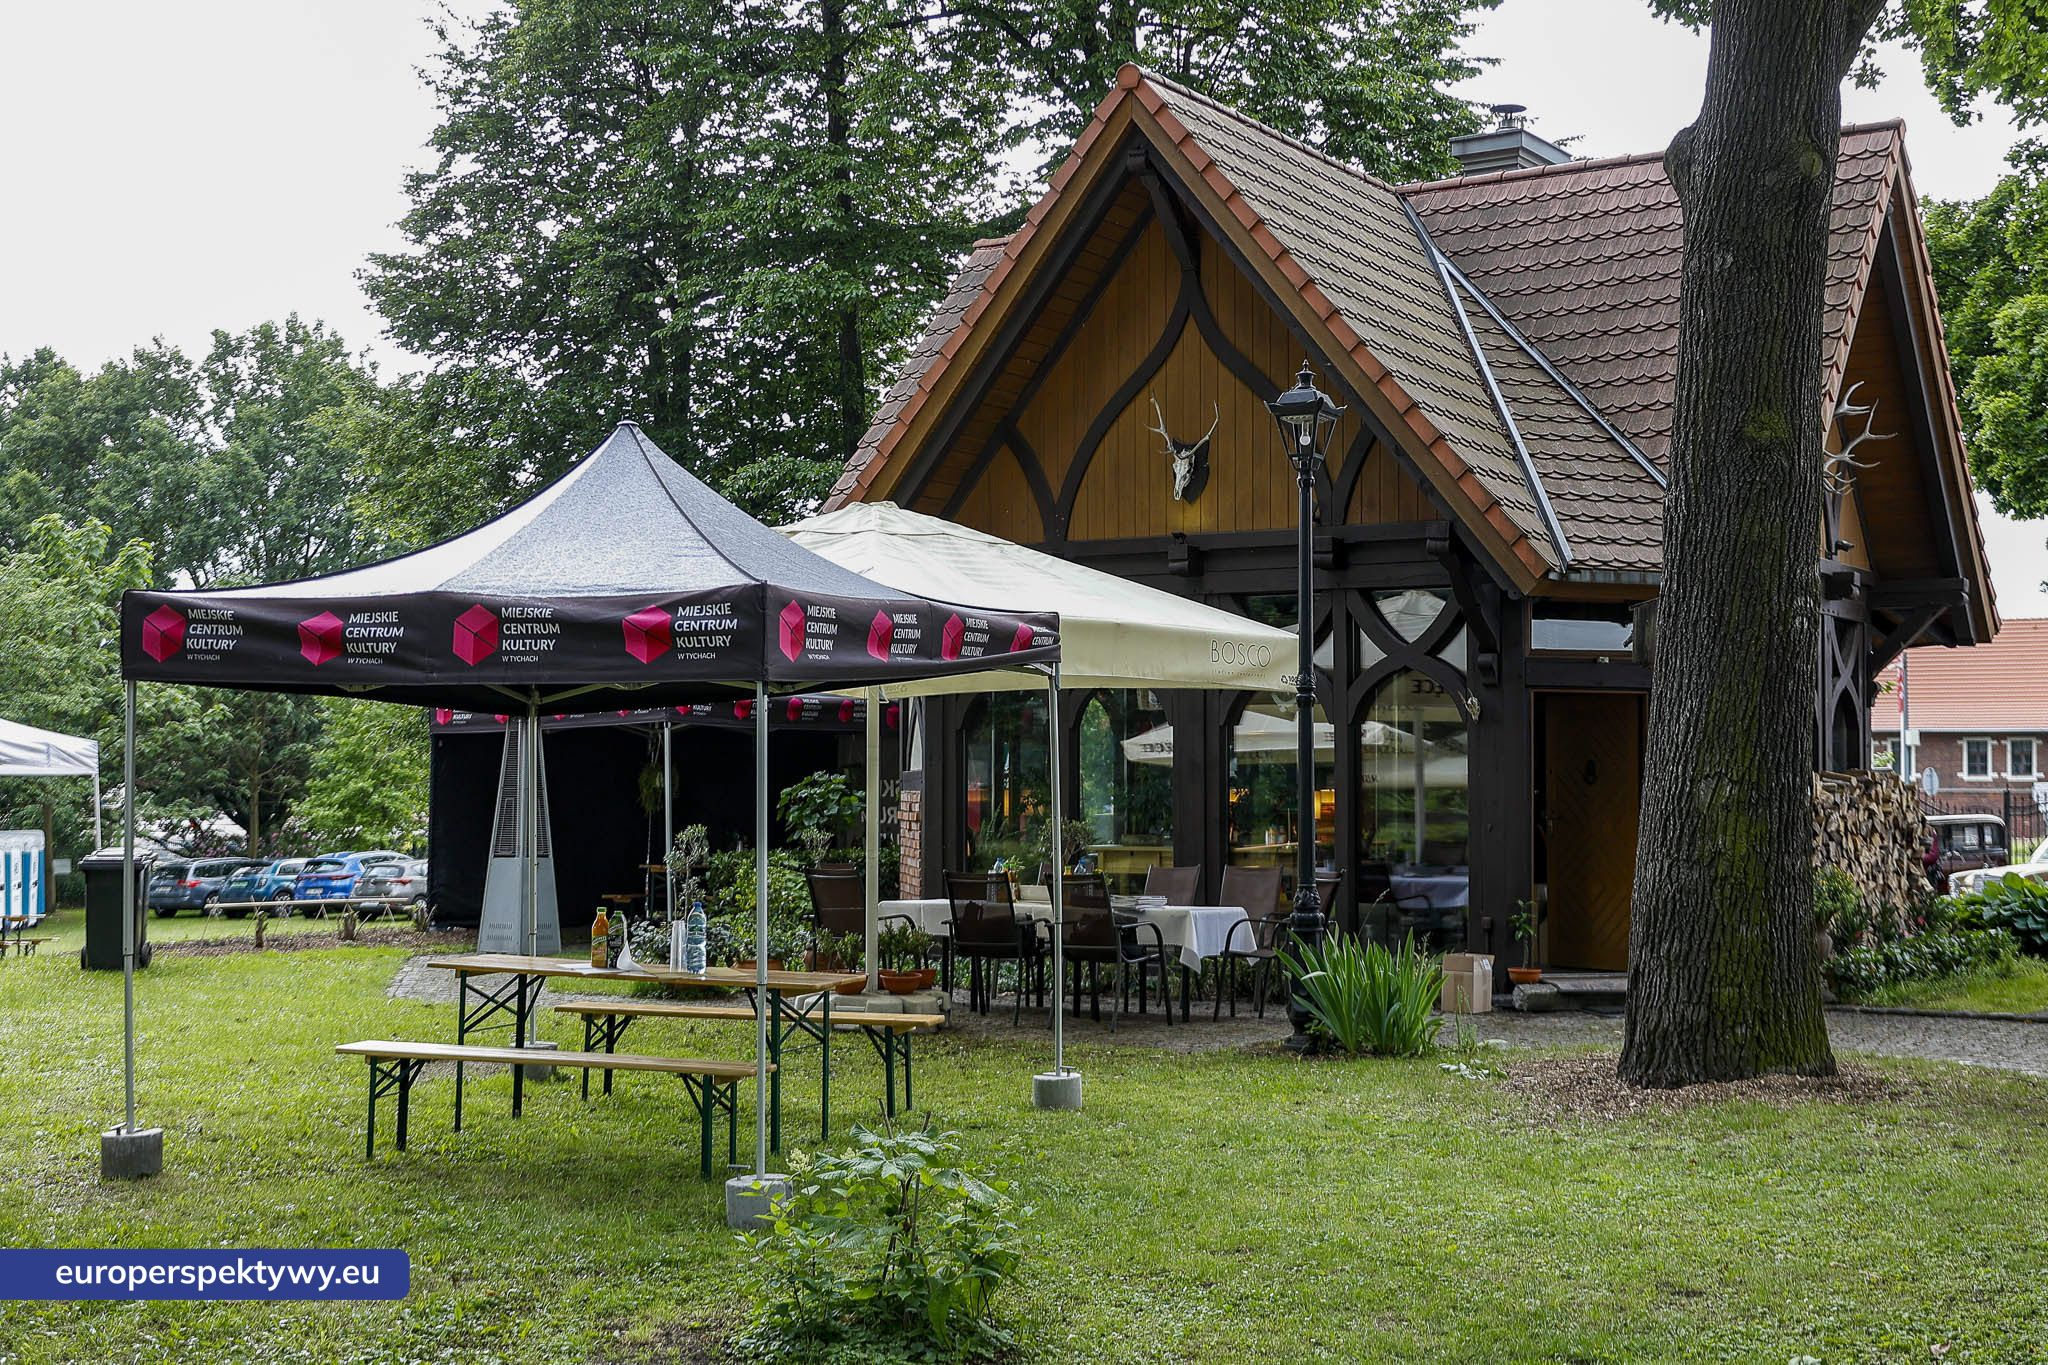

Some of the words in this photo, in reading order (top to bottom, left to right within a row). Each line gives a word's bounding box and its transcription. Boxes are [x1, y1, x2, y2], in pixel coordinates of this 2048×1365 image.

[188, 609, 234, 620] MIEJSKIE
[501, 607, 554, 618] MIEJSKIE
[677, 603, 732, 617] MIEJSKIE
[807, 605, 837, 619] MIEJSKIE
[349, 611, 399, 623] MIEJSKIE
[892, 613, 918, 624] MIEJSKIE
[965, 617, 989, 629] MIEJSKIE
[189, 624, 243, 636] CENTRUM
[503, 623, 560, 634] CENTRUM
[674, 618, 738, 631] CENTRUM
[806, 622, 838, 635] CENTRUM
[345, 627, 404, 638] CENTRUM
[893, 628, 921, 639] CENTRUM
[963, 631, 990, 643] CENTRUM
[186, 638, 237, 650] KULTURY
[502, 639, 556, 651] KULTURY
[676, 635, 732, 648] KULTURY
[805, 638, 834, 650] KULTURY
[1031, 636, 1055, 646] CENTRUM
[346, 642, 397, 653] KULTURY
[890, 643, 918, 654] KULTURY
[960, 646, 985, 657] KULTURY
[677, 652, 685, 660] W
[1211, 640, 1271, 668] BOSCO
